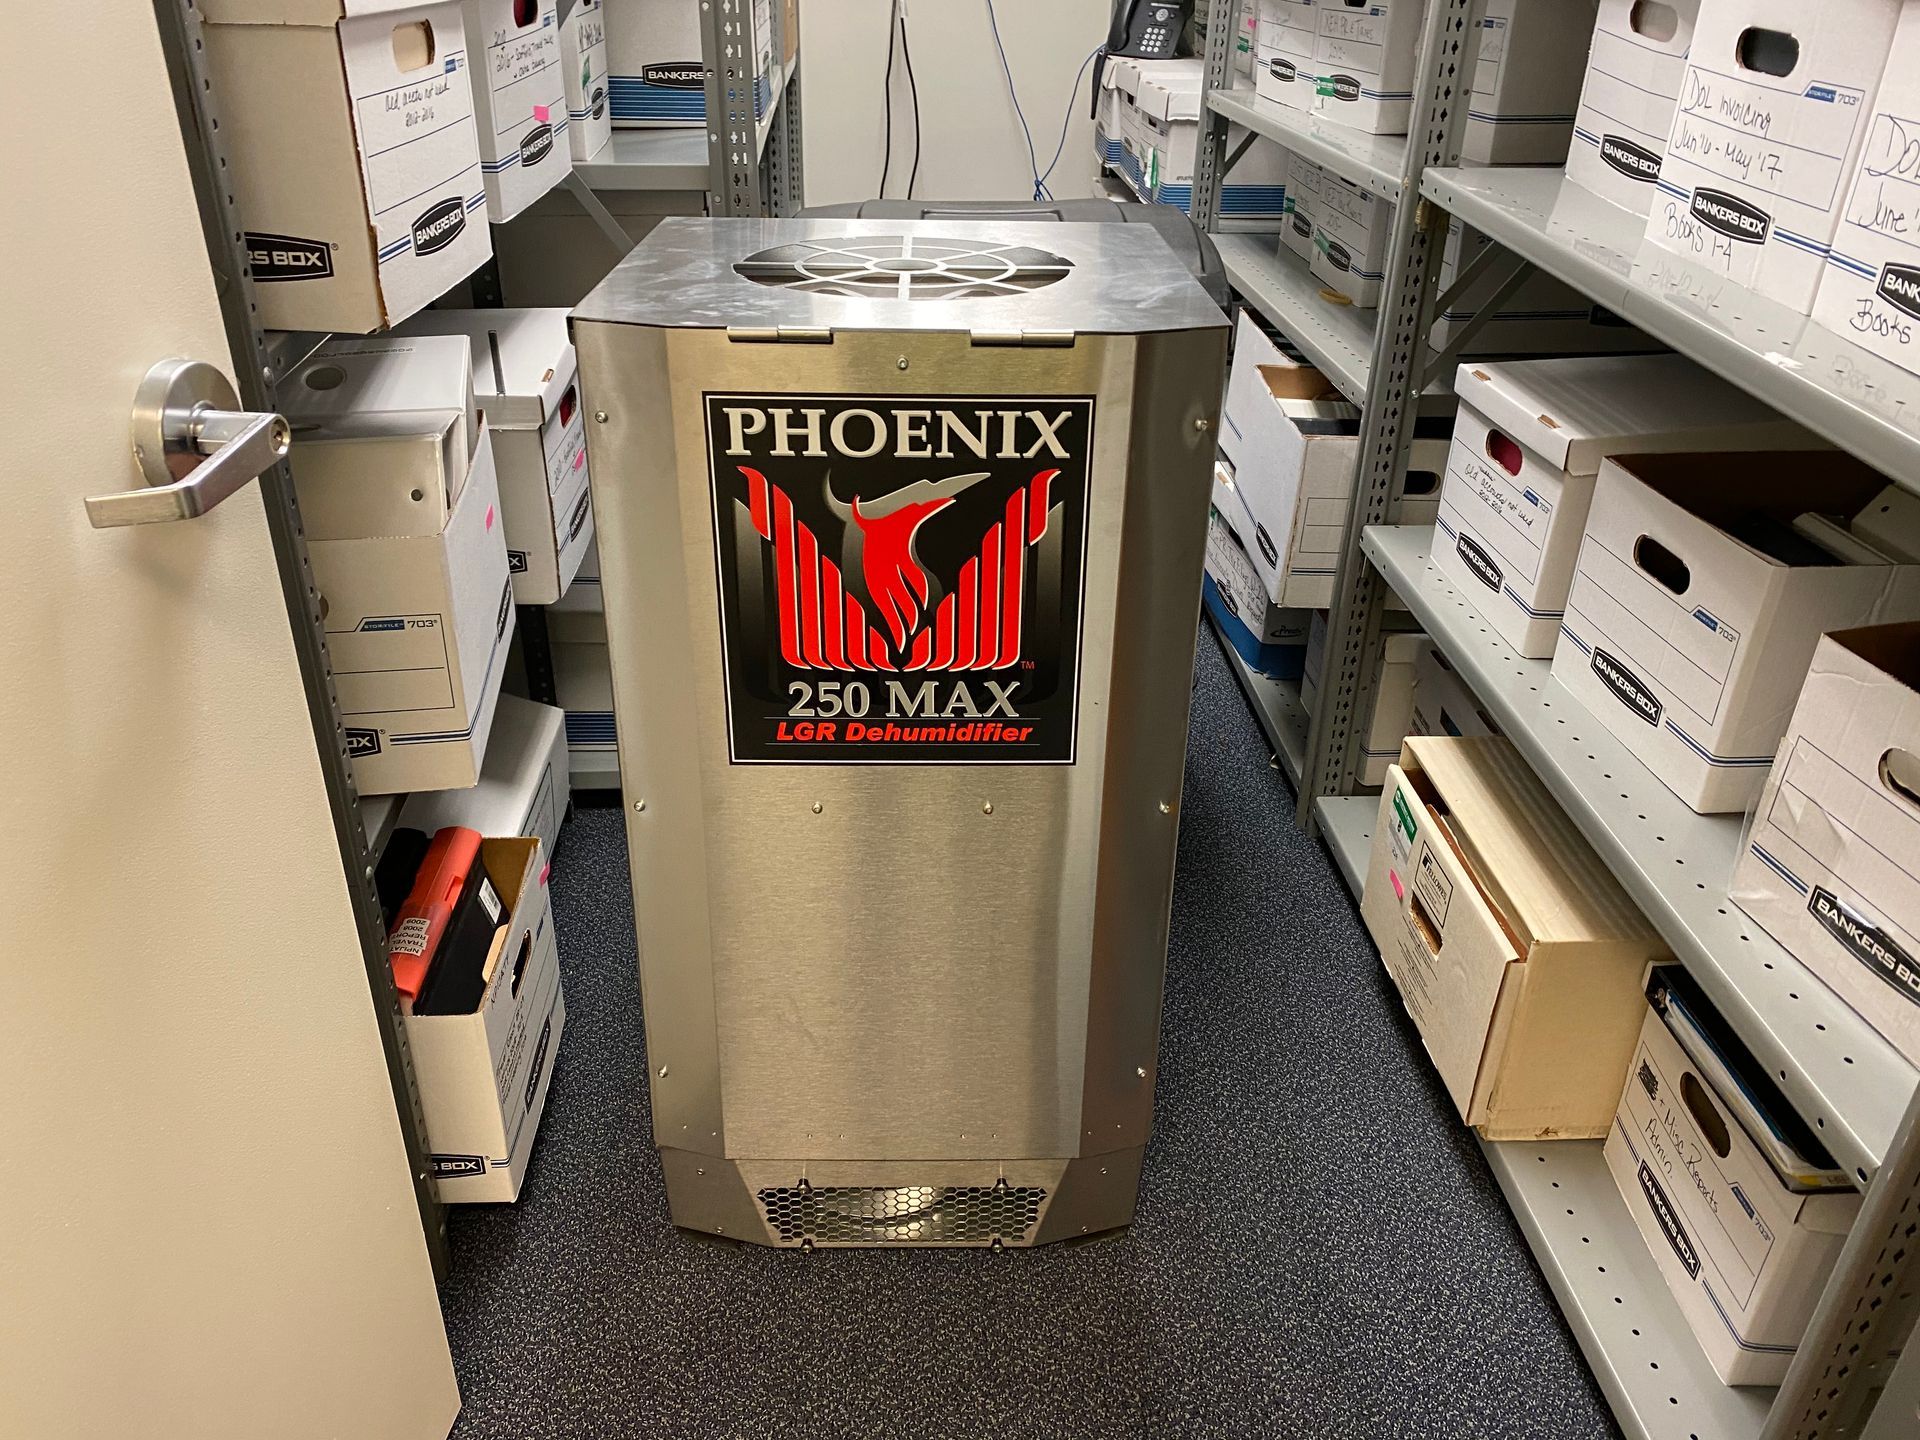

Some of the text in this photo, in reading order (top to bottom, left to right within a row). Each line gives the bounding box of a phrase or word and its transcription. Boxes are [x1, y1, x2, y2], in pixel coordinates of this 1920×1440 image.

[1684, 70, 1711, 111] DOL
[1604, 142, 1660, 175] BANKERS BOX
[1724, 142, 1752, 180] May
[416, 206, 464, 246] BANKERS BOX
[1664, 202, 1704, 253] Books
[1694, 195, 1766, 235] BANKERS BOX
[1858, 182, 1908, 233] June
[273, 250, 324, 268] BOX
[1850, 299, 1911, 345] Books
[722, 407, 1072, 459] PHOENIX
[1459, 540, 1500, 585] BANKERS BOX
[787, 680, 1020, 717] 250 MAX
[1595, 656, 1658, 718] BANKERS BOX
[776, 722, 1033, 742] LGR Dehumidifier
[1816, 897, 1896, 970] BANKERS
[440, 1161, 479, 1171] BOX
[1686, 1143, 1719, 1214] Reports
[1641, 1169, 1697, 1270] BANKERS BOX
